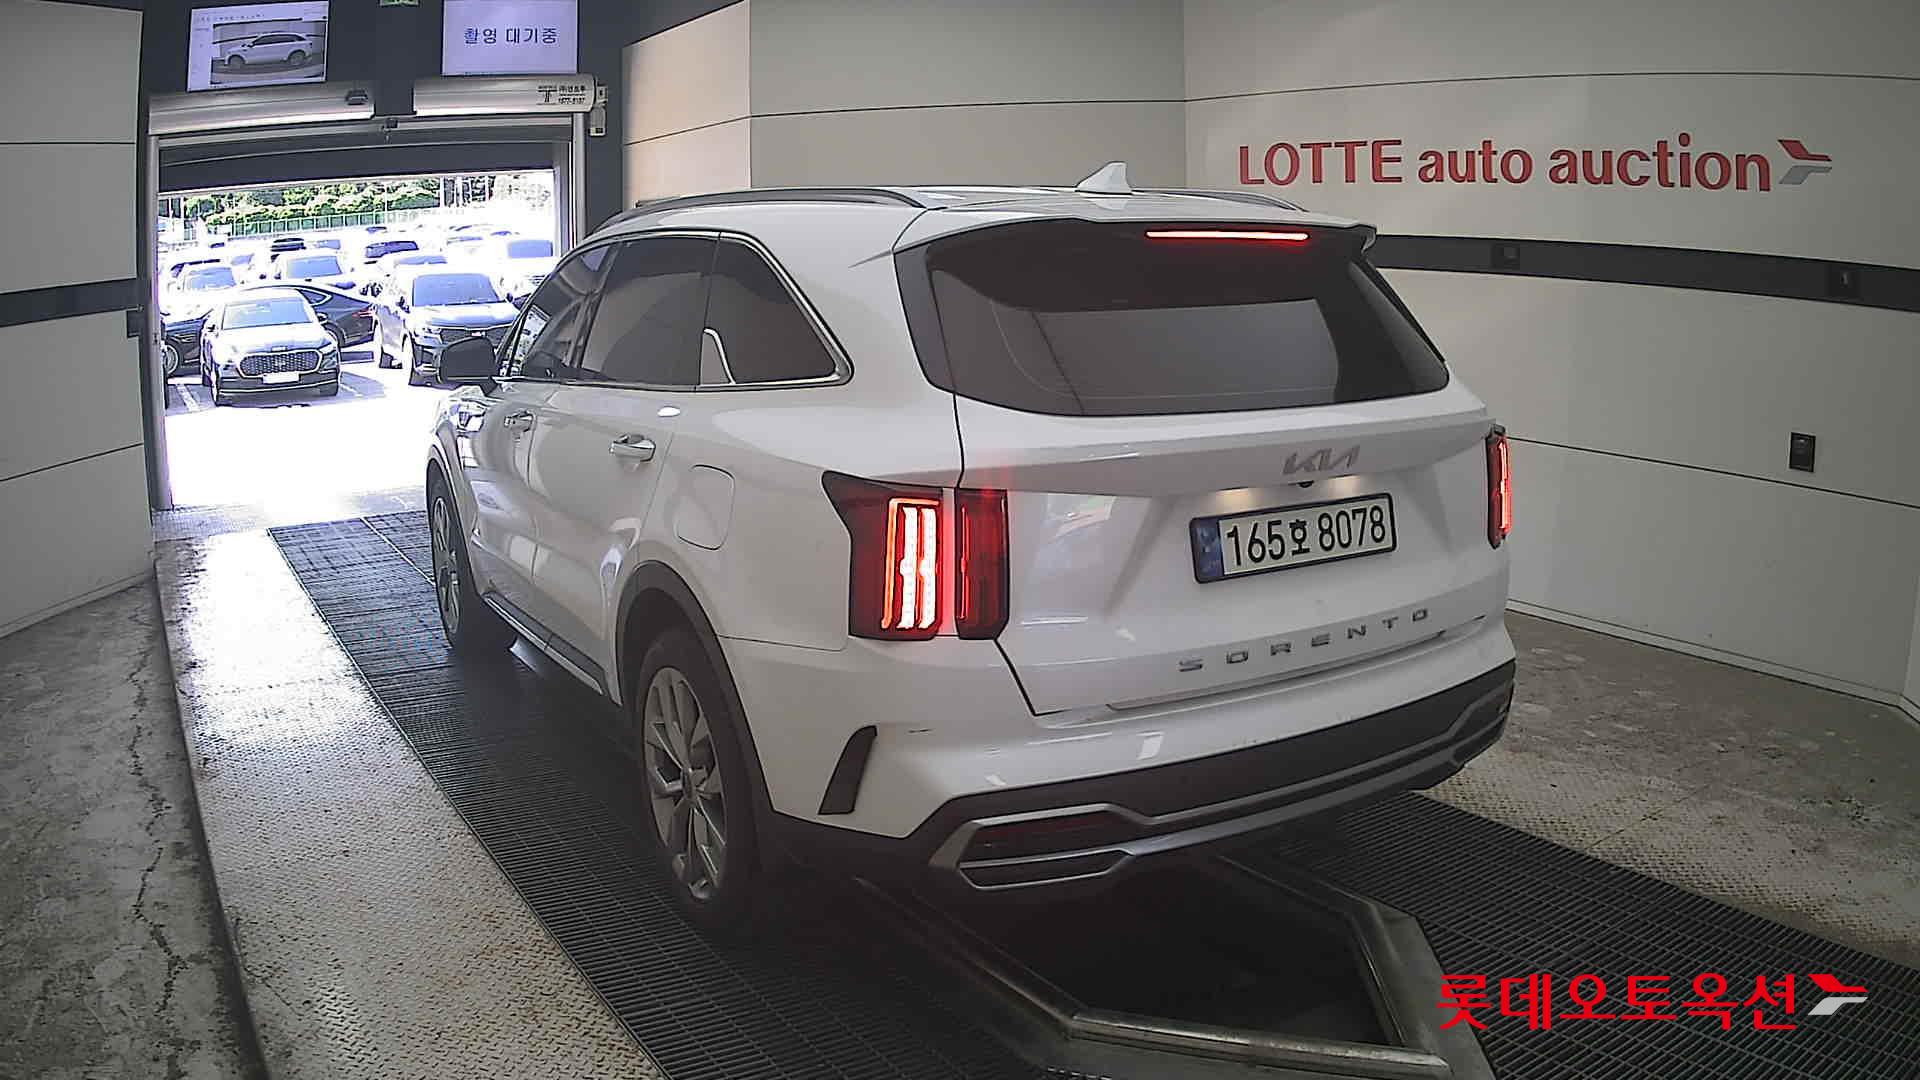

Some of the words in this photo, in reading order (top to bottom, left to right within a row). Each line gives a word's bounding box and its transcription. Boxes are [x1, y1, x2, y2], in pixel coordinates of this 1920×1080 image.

[506, 27, 557, 44] 대기중
[1238, 139, 1402, 186] LOTTE
[1418, 139, 1533, 184] auto
[1549, 133, 1772, 192] auction
[1226, 518, 1310, 564] 165호
[1318, 505, 1386, 552] 8078
[1179, 608, 1428, 673] SORENTO
